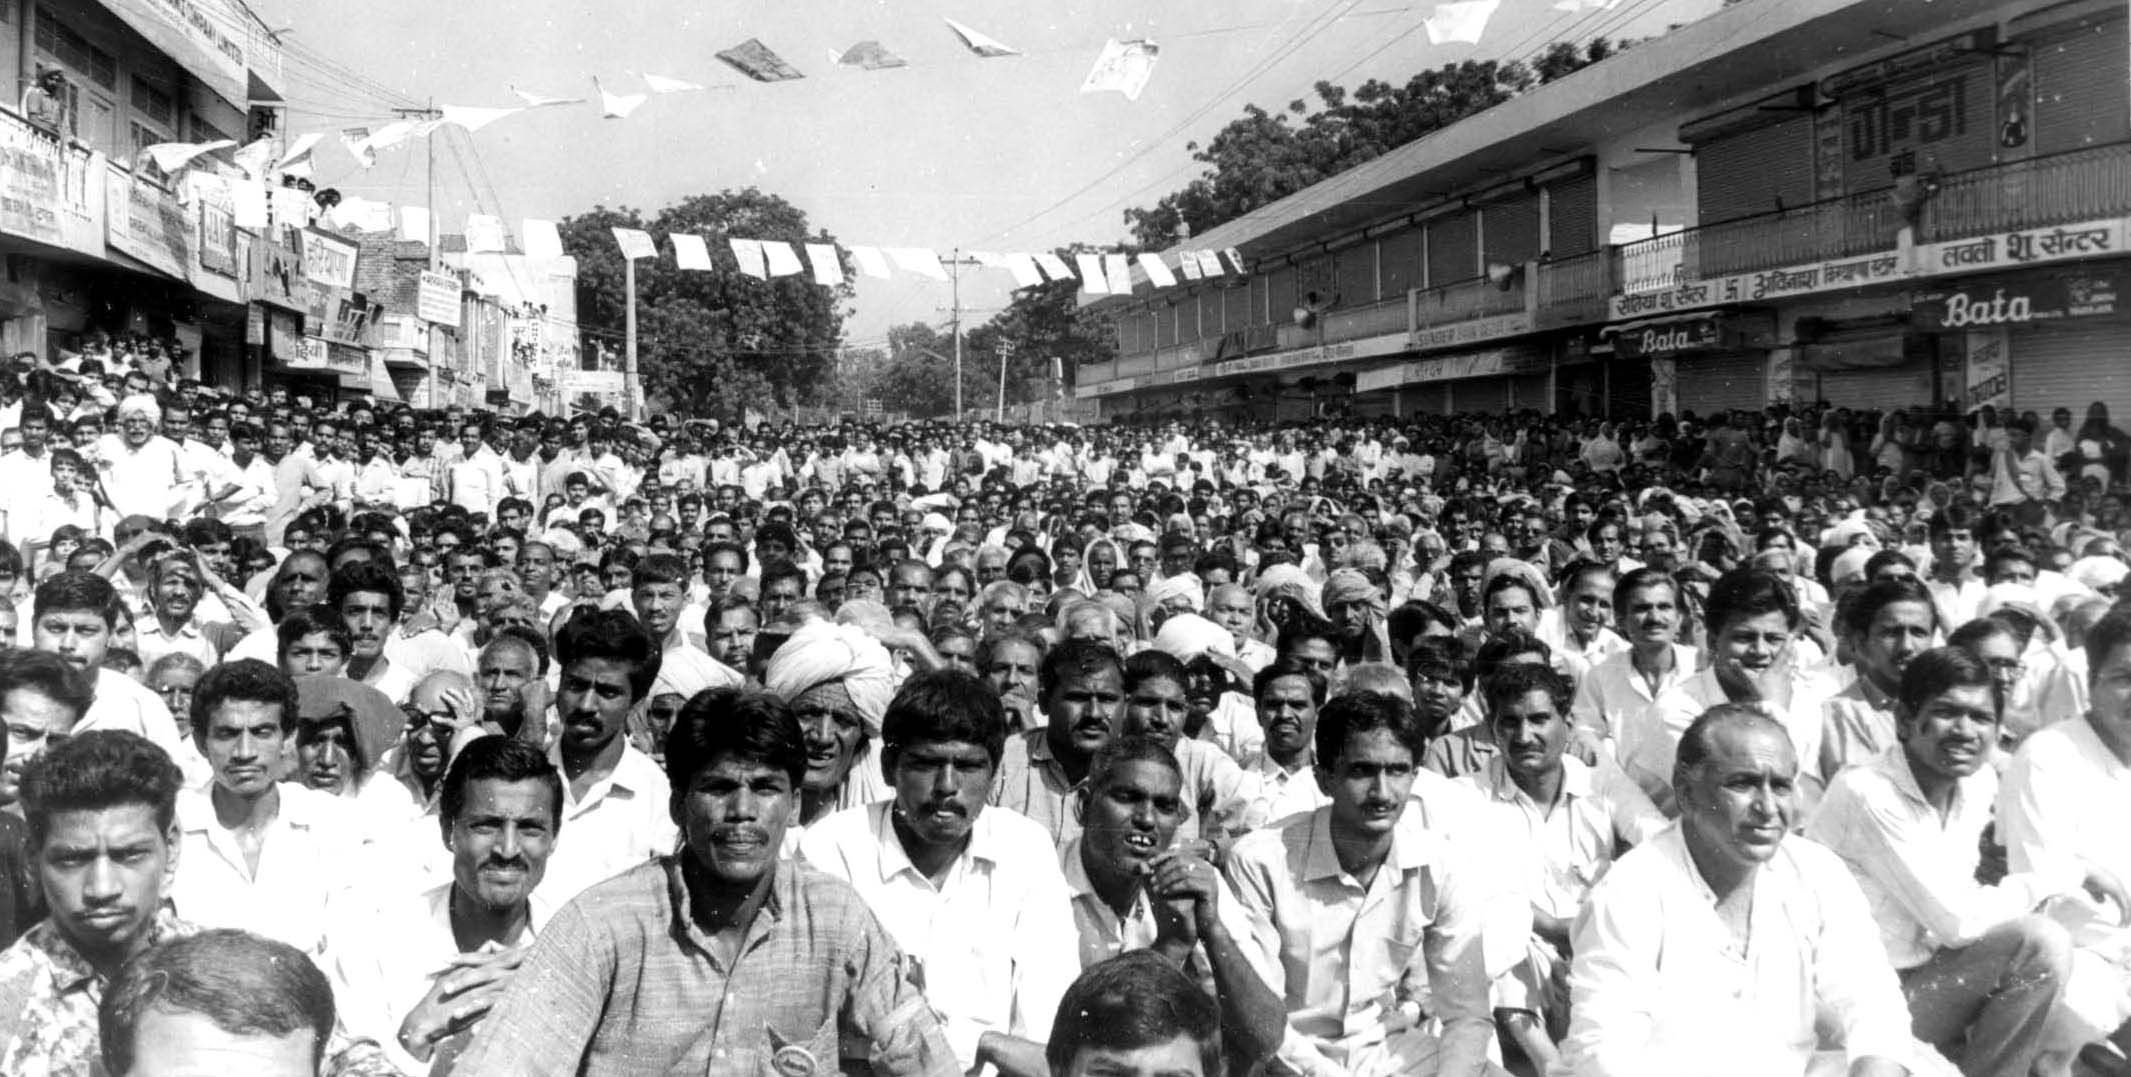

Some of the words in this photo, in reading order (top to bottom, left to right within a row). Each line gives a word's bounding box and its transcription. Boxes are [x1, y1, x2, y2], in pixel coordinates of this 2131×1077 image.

[2007, 233, 2038, 262] शू
[1660, 291, 1675, 311] शू
[1940, 288, 2032, 328] Bata
[1640, 328, 1689, 354] Bata
